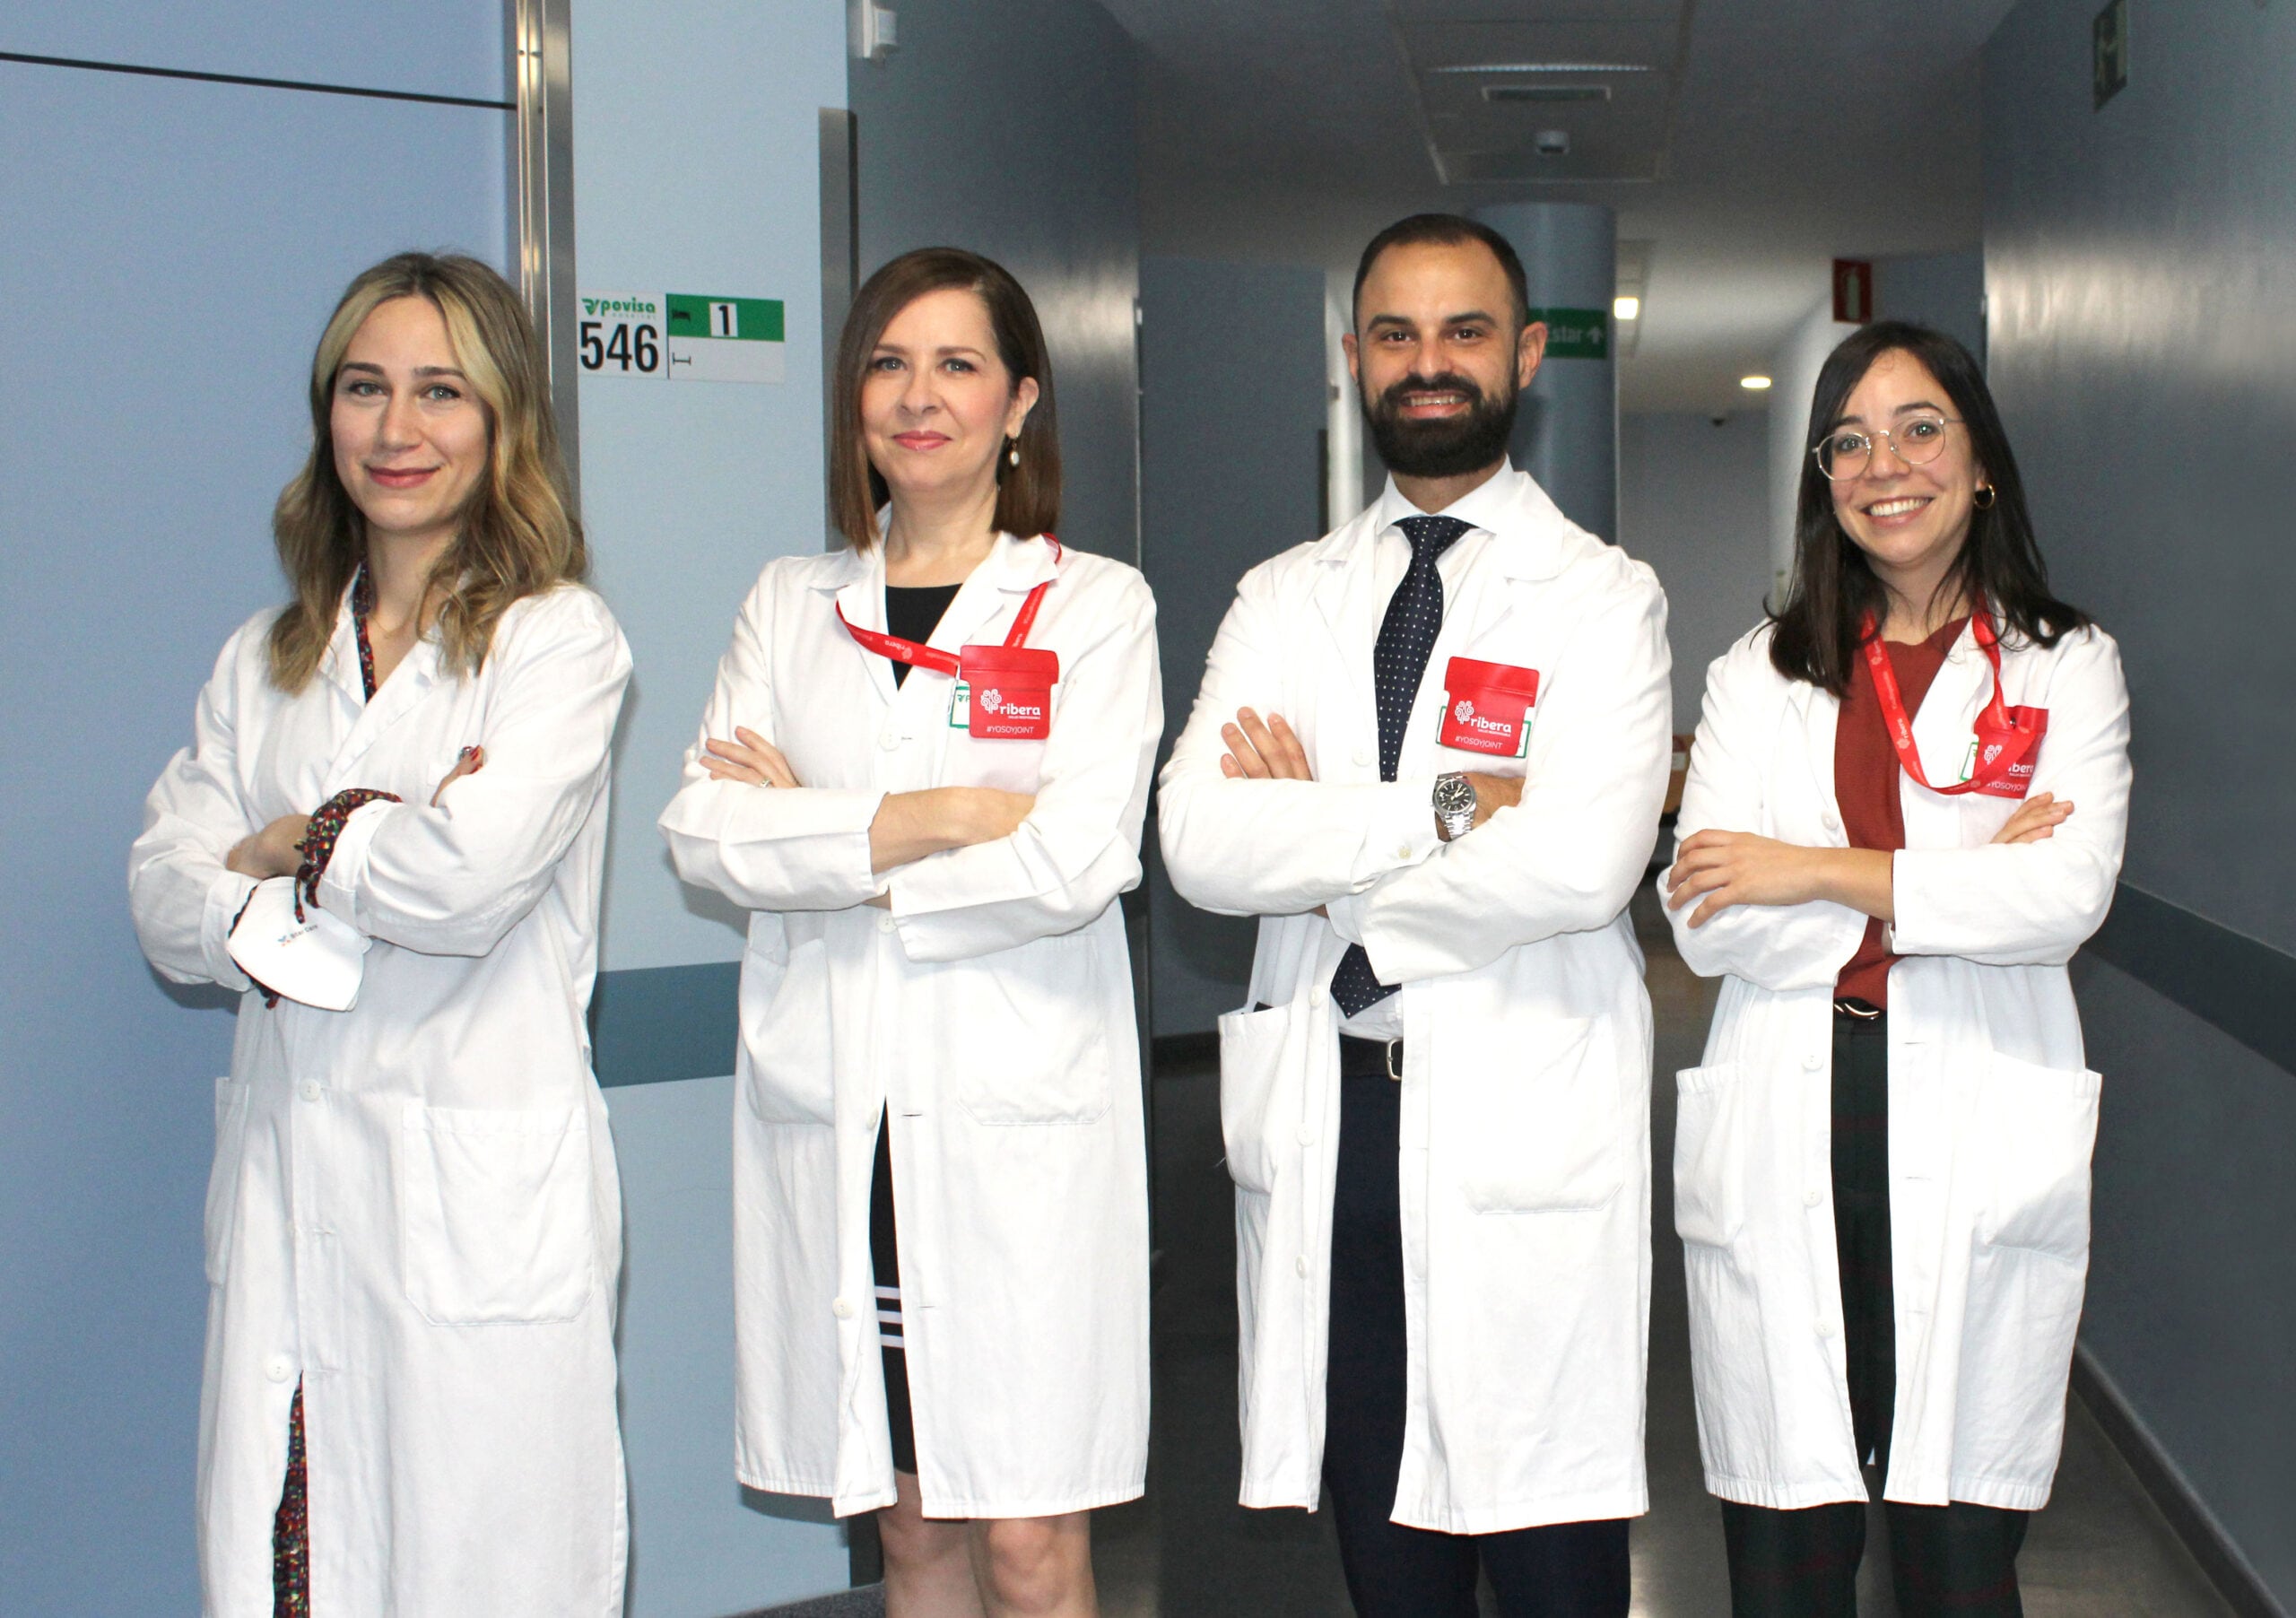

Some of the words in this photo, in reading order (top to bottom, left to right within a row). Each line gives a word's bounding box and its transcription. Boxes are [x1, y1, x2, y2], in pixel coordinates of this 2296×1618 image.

[600, 296, 656, 317] povisa
[718, 305, 730, 336] 1
[579, 321, 659, 373] 546
[1000, 703, 1040, 715] ribera
[987, 726, 1035, 735] #YOSOYJOINT
[1471, 716, 1512, 733] ribera
[1456, 735, 1503, 749] #YOSOYJOINT
